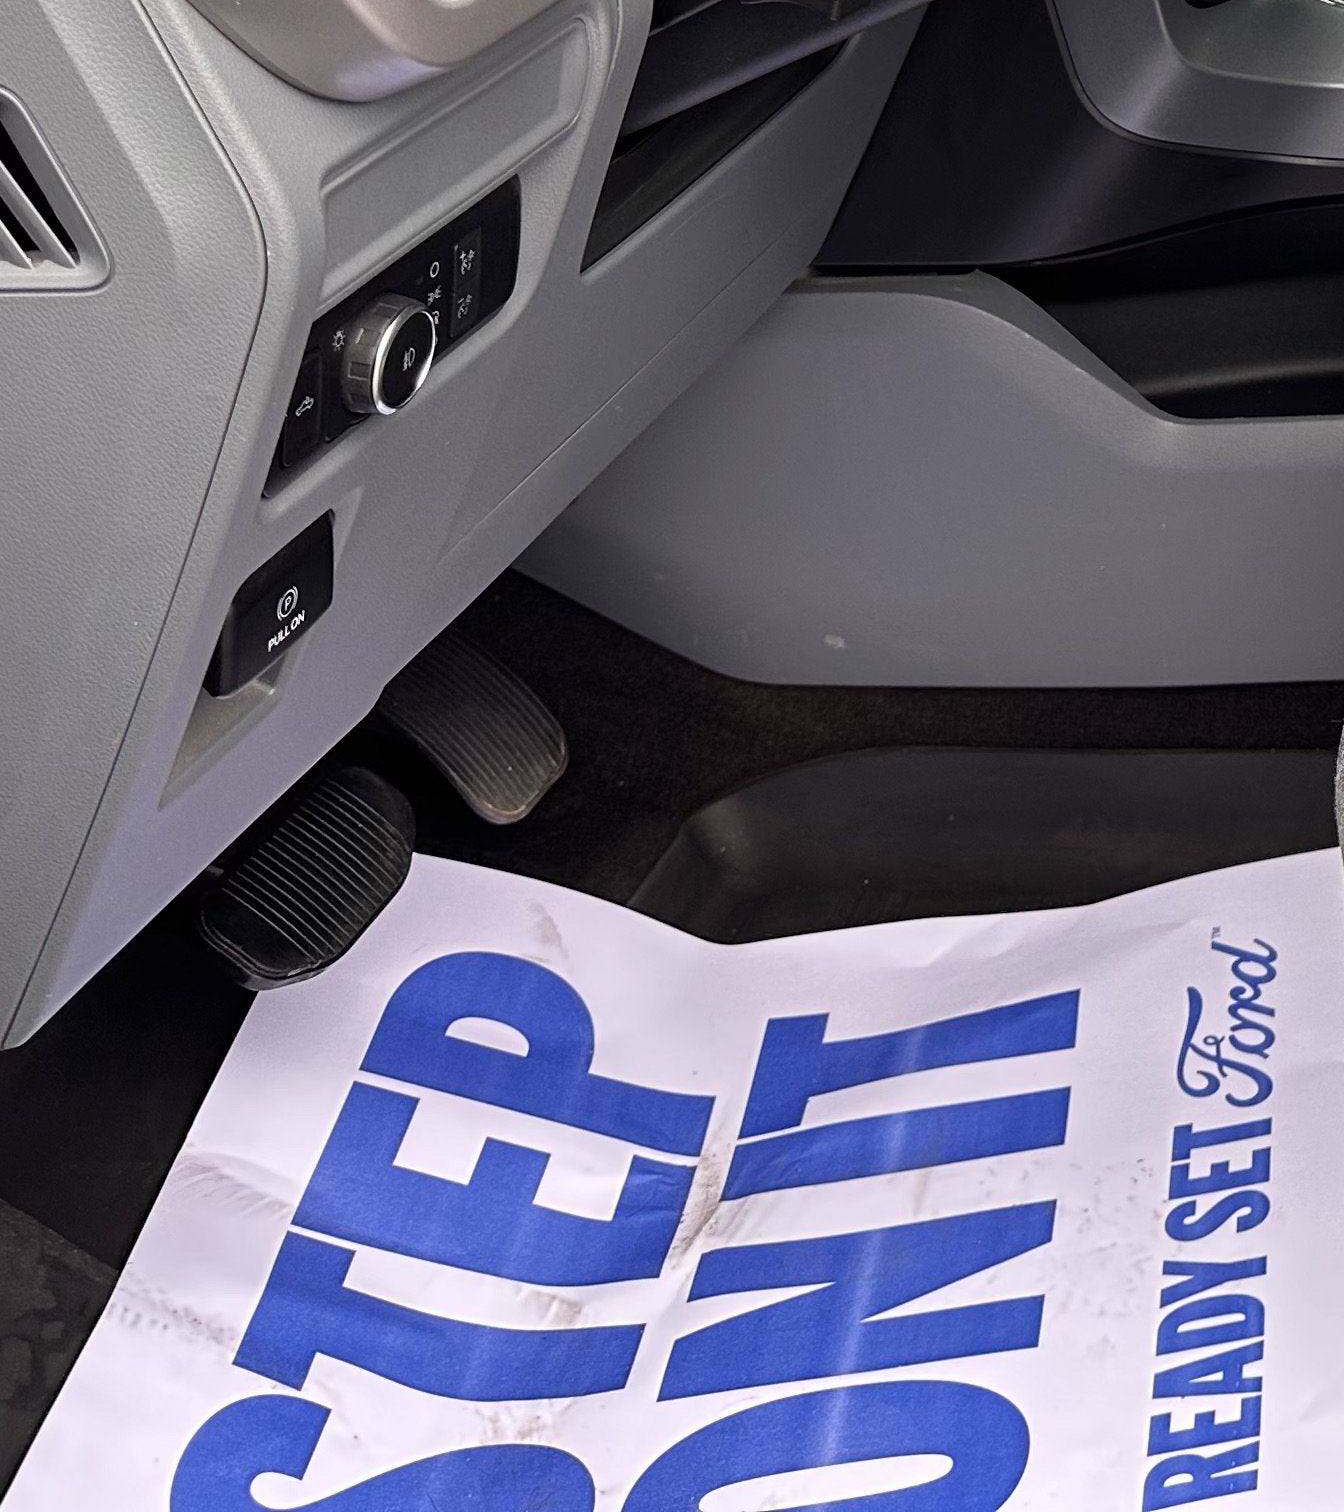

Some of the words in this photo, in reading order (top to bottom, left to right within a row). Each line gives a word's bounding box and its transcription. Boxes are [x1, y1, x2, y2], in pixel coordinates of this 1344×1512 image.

[267, 625, 291, 653] PULL
[290, 609, 306, 631] ON
[721, 989, 1081, 1201] IT
[1177, 937, 1278, 1108] Ford
[169, 951, 715, 1512] STEP
[1164, 1118, 1273, 1241] SET
[620, 1200, 1056, 1512] ON
[1141, 1256, 1268, 1512] READY
